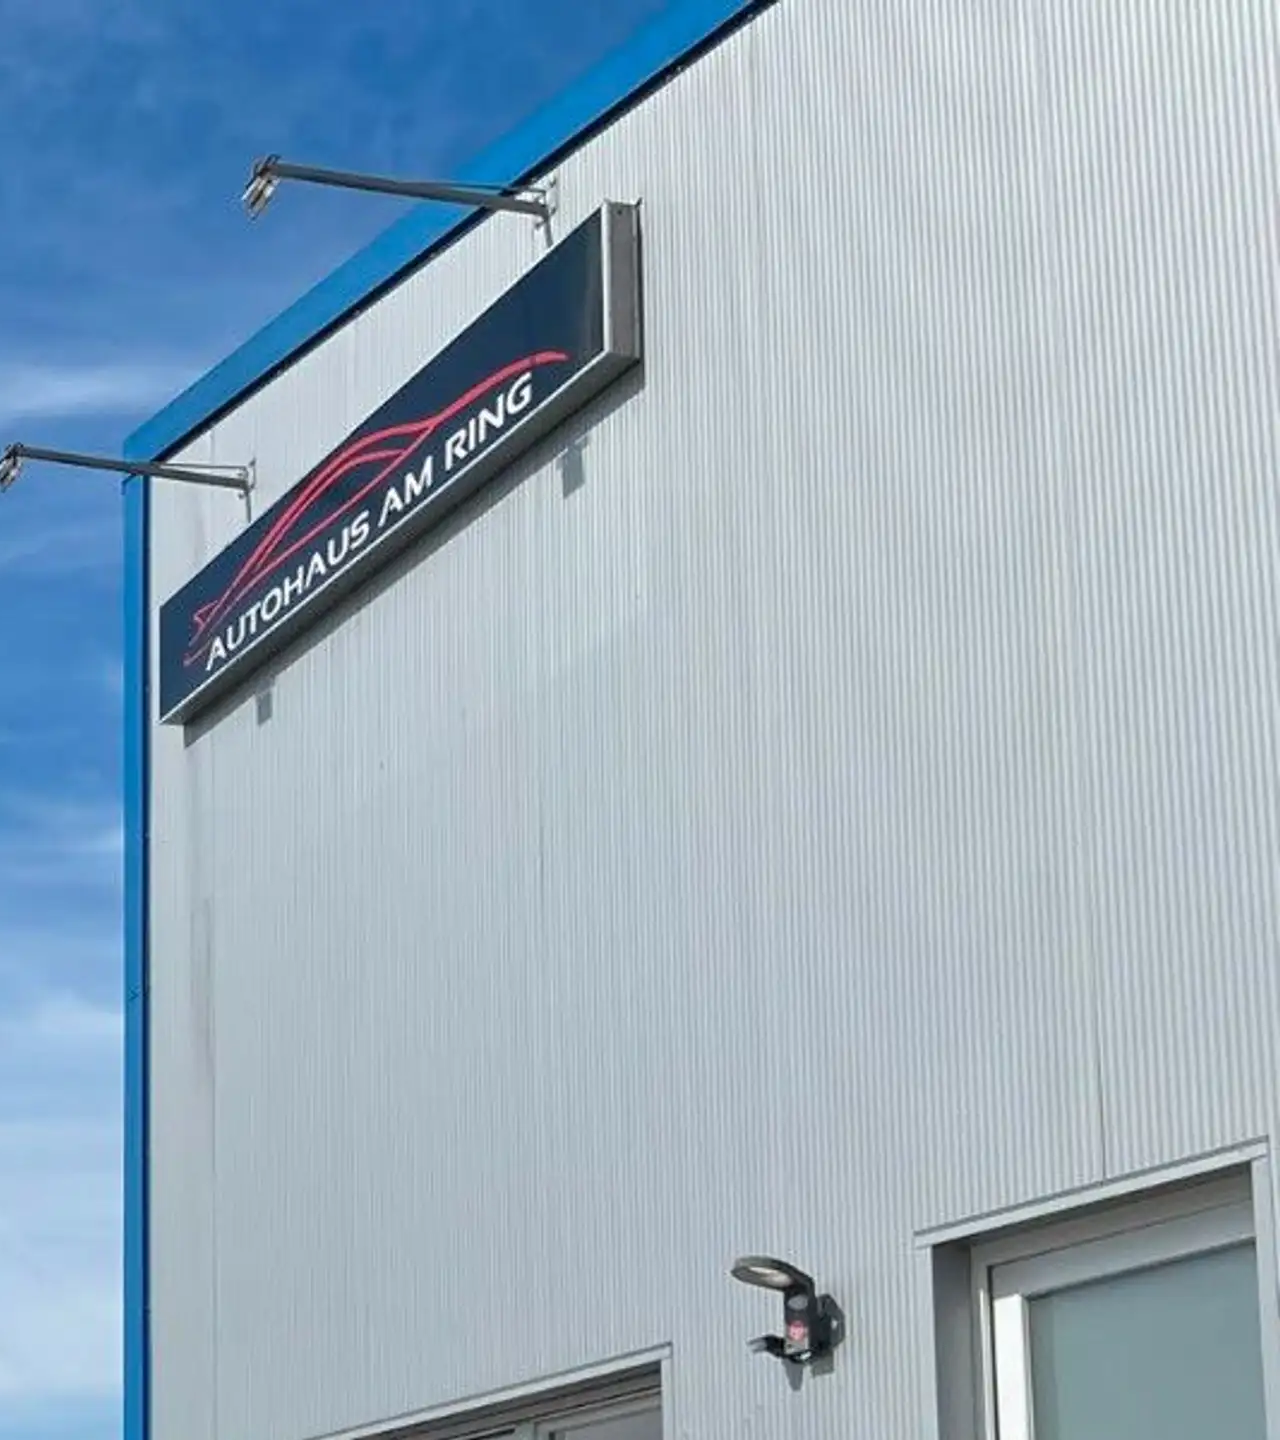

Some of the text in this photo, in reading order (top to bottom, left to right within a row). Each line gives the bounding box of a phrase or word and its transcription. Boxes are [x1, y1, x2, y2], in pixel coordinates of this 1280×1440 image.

[206, 371, 533, 671] AUTOHAUS AM RING
